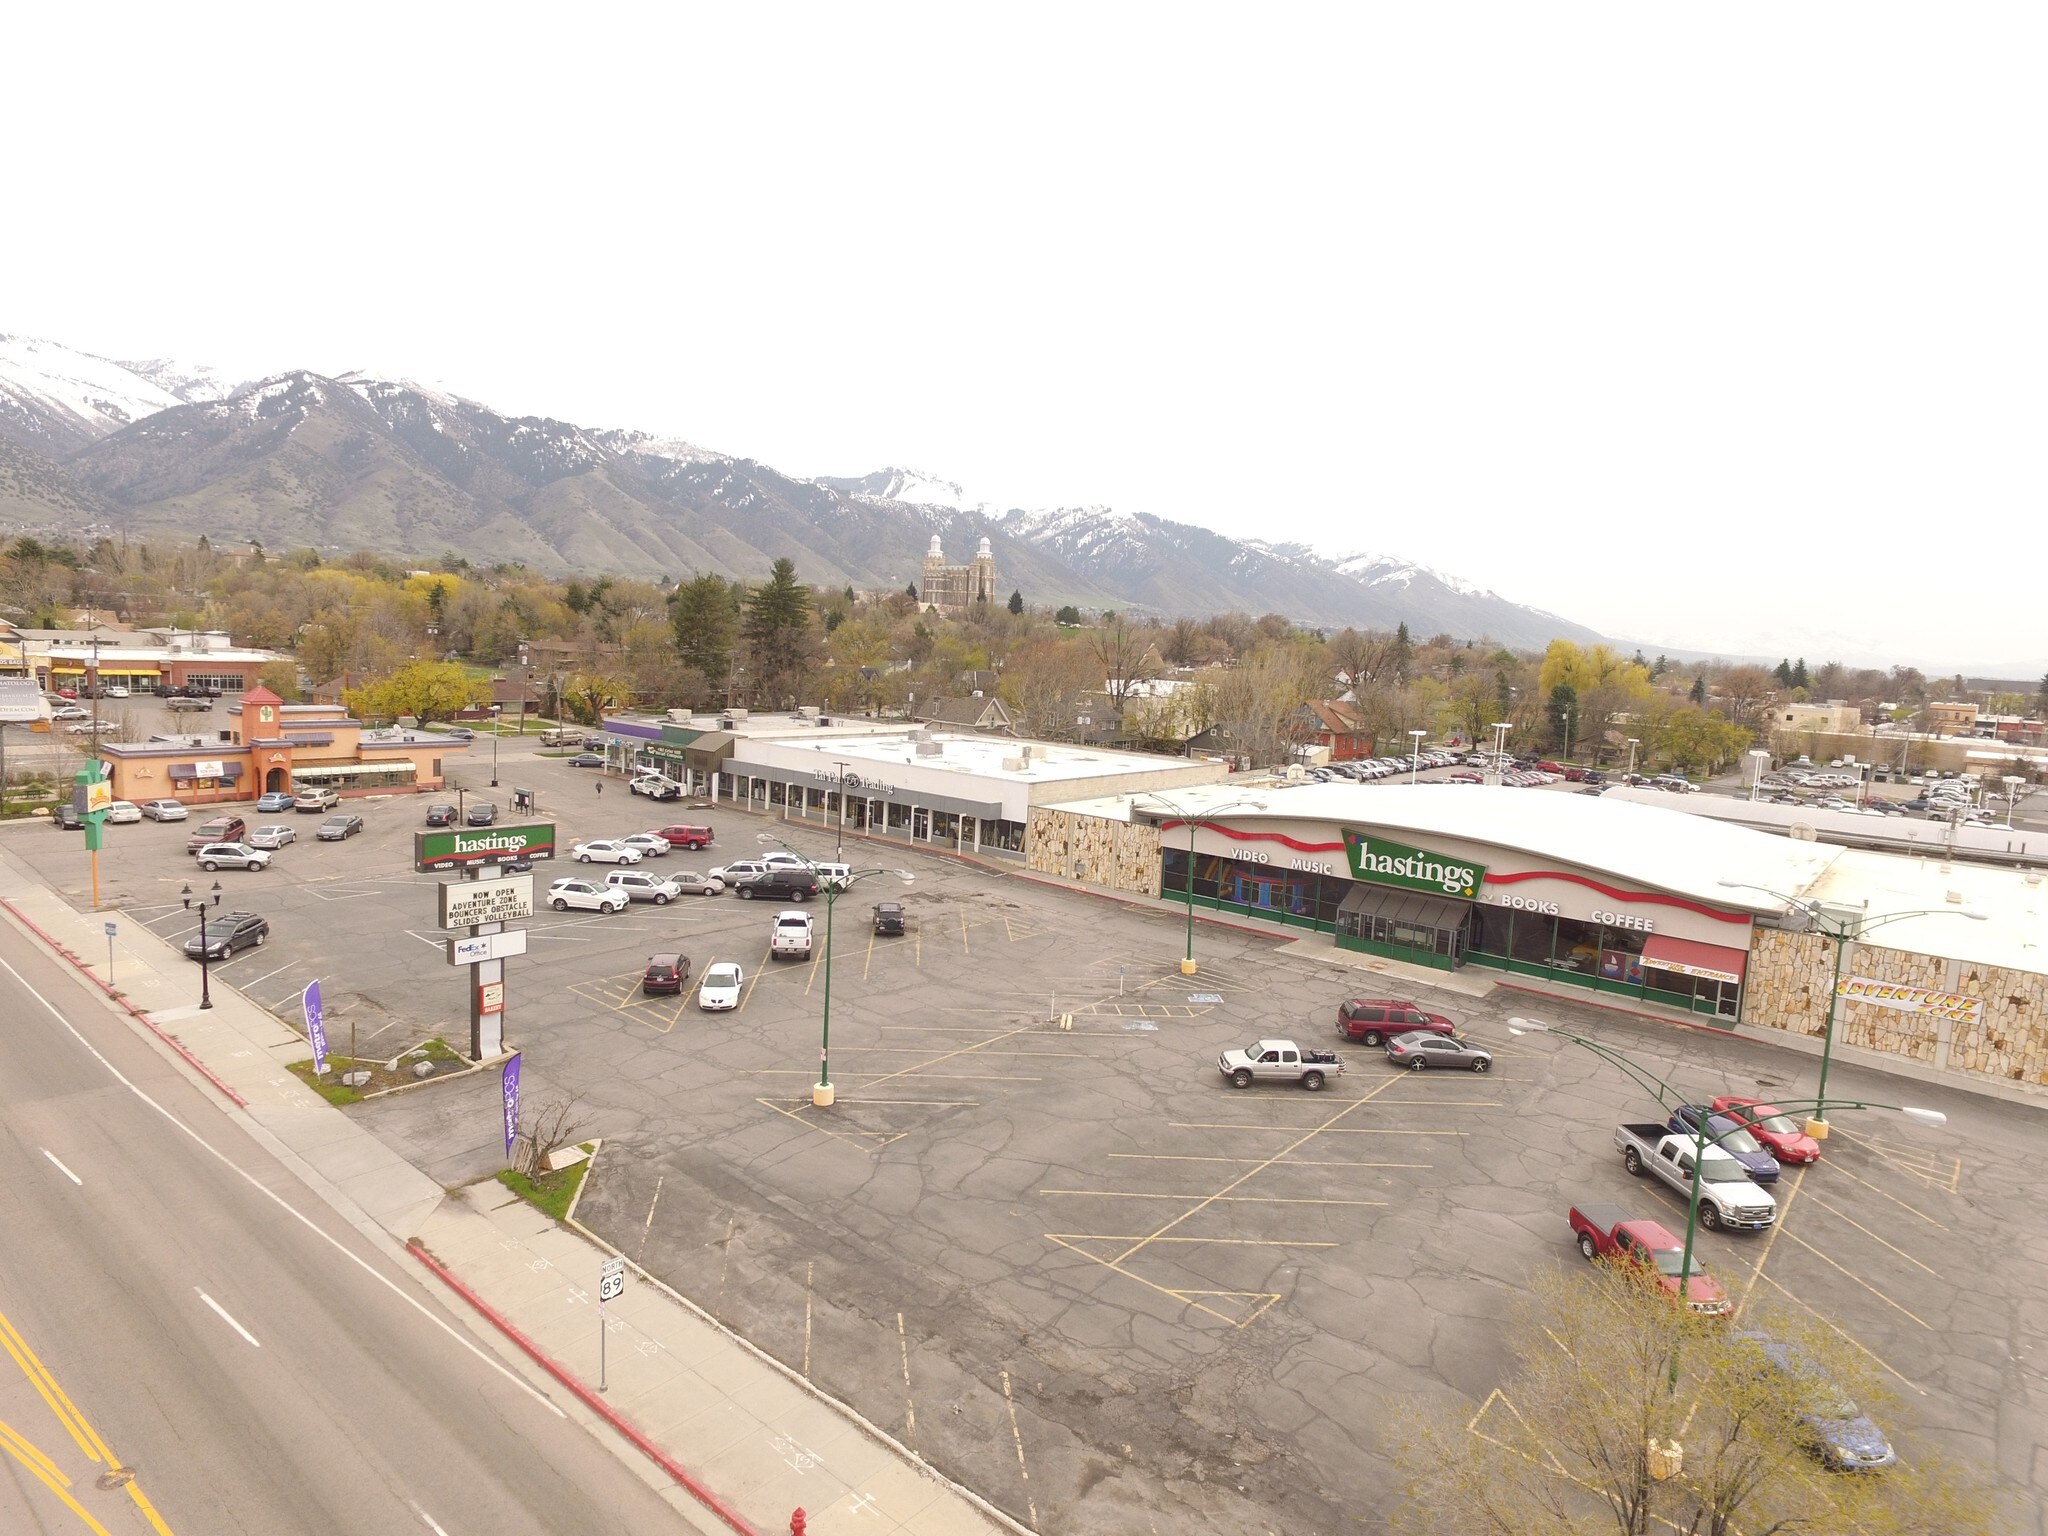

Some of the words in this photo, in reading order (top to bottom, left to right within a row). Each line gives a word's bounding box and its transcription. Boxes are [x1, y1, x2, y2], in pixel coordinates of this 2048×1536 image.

[814, 769, 826, 780] Tai
[860, 778, 894, 795] Trading
[454, 832, 527, 853] hastings
[1231, 848, 1268, 864] VIDEO
[1291, 858, 1332, 875] MUSIC
[1358, 842, 1474, 893] hastings
[473, 891, 489, 899] NOW
[496, 887, 515, 896] OPEN
[449, 907, 488, 919] BOUNCERS
[491, 901, 527, 913] OBSTACLE
[452, 898, 496, 911] ADVENTURE
[500, 895, 518, 903] ZONE
[453, 916, 479, 926] SLIDES
[484, 909, 530, 922] VOLLEYBALL
[1501, 894, 1559, 915] BOOKS
[1591, 910, 1653, 932] COFFEE
[458, 943, 480, 954] FedEx
[1690, 968, 1736, 981] ENTRANCE
[1830, 981, 1981, 1011] ADVENTURE
[484, 1004, 502, 1013] BAKERY
[1914, 1004, 1978, 1022] ZONE
[307, 1004, 324, 1060] metroPCS
[504, 1074, 515, 1139] metroPCS
[603, 1260, 622, 1273] NORTH
[603, 1278, 621, 1294] 89
